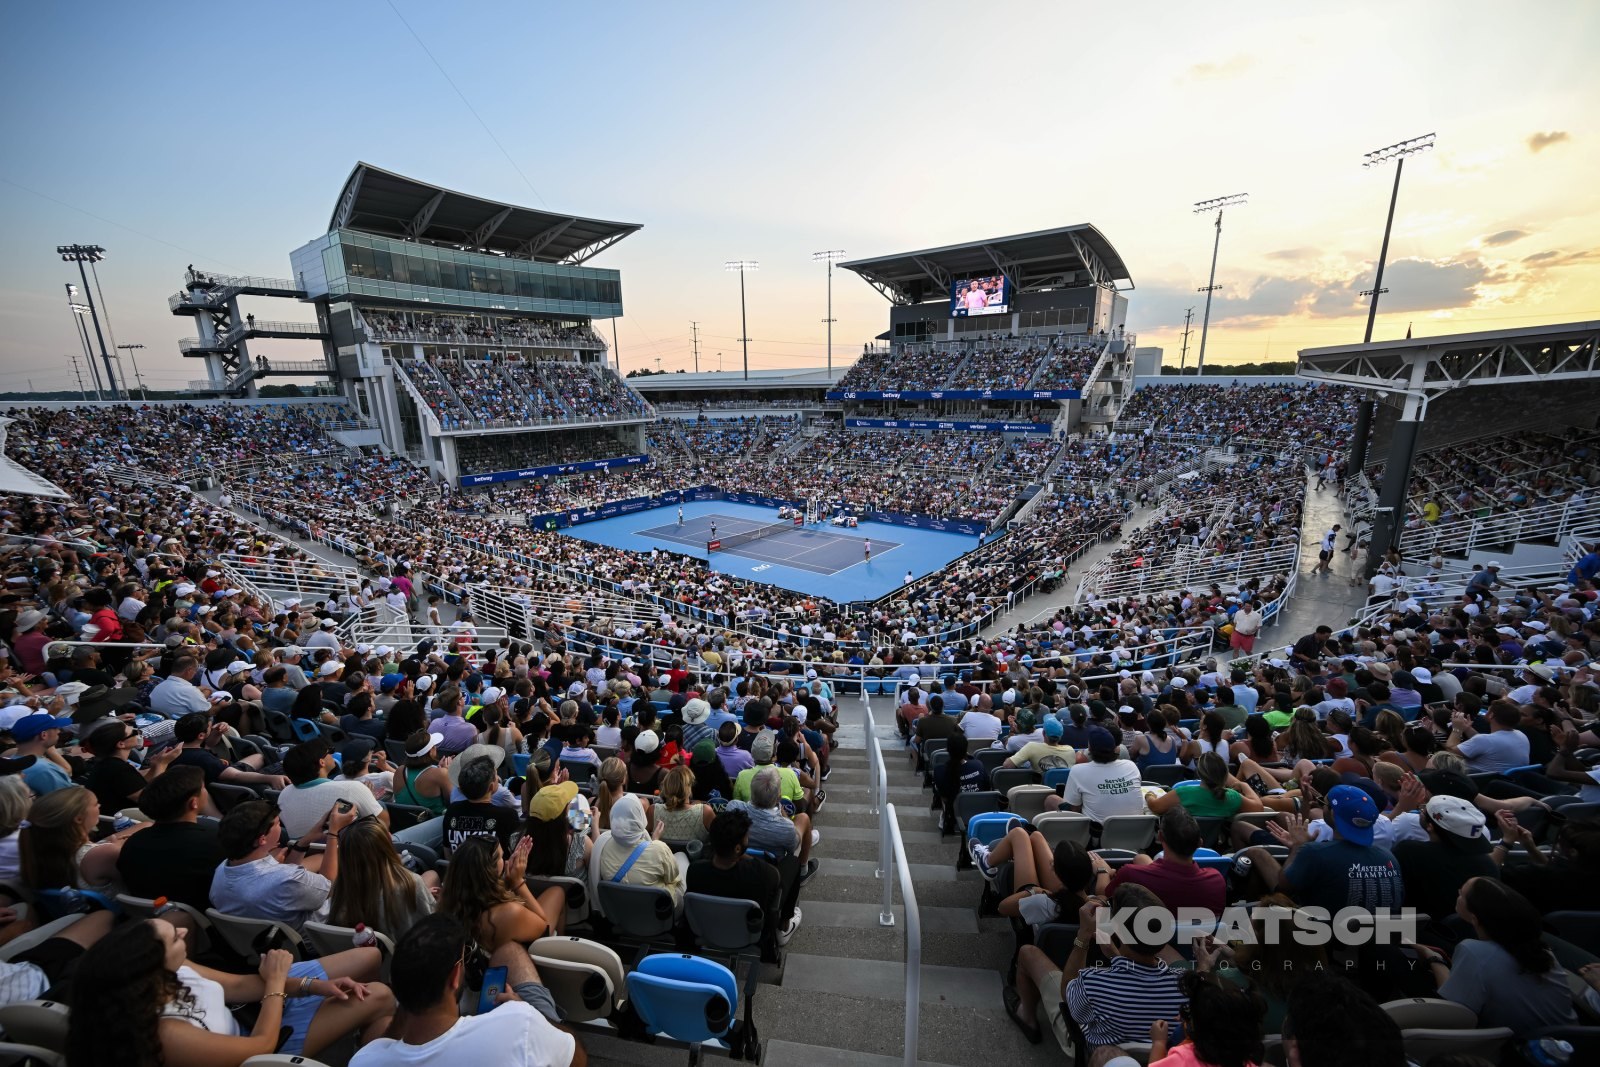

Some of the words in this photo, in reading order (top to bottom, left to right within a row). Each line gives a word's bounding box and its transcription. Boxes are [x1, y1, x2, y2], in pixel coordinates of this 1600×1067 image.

[474, 475, 493, 483] betway
[1098, 780, 1133, 789] CHUCKERS
[1471, 825, 1483, 837] F
[1348, 869, 1400, 879] CHAMPION
